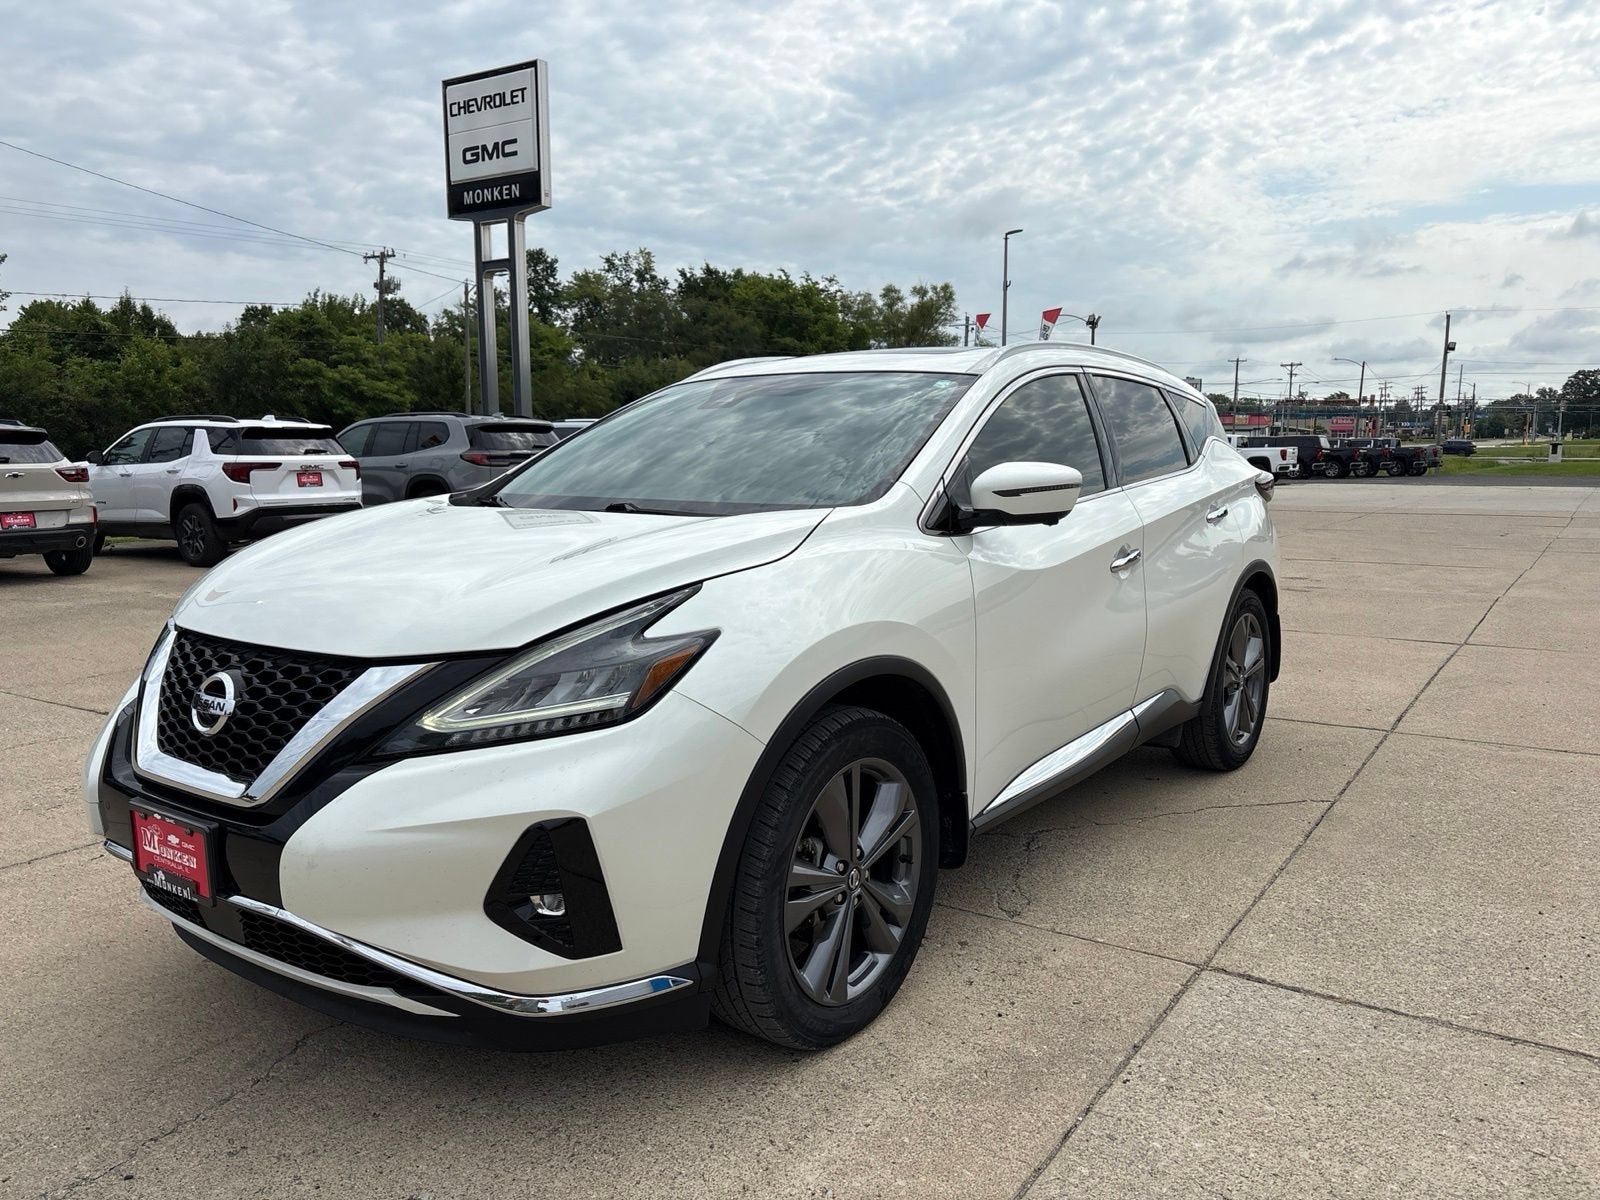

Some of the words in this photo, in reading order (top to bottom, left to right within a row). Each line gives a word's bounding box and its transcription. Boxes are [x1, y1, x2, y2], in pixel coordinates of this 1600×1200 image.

[449, 87, 527, 118] CHEVROLET
[462, 138, 518, 165] GMC
[463, 183, 520, 206] MONKEN
[194, 694, 225, 711] ISSAN
[141, 826, 197, 869] MONKEN
